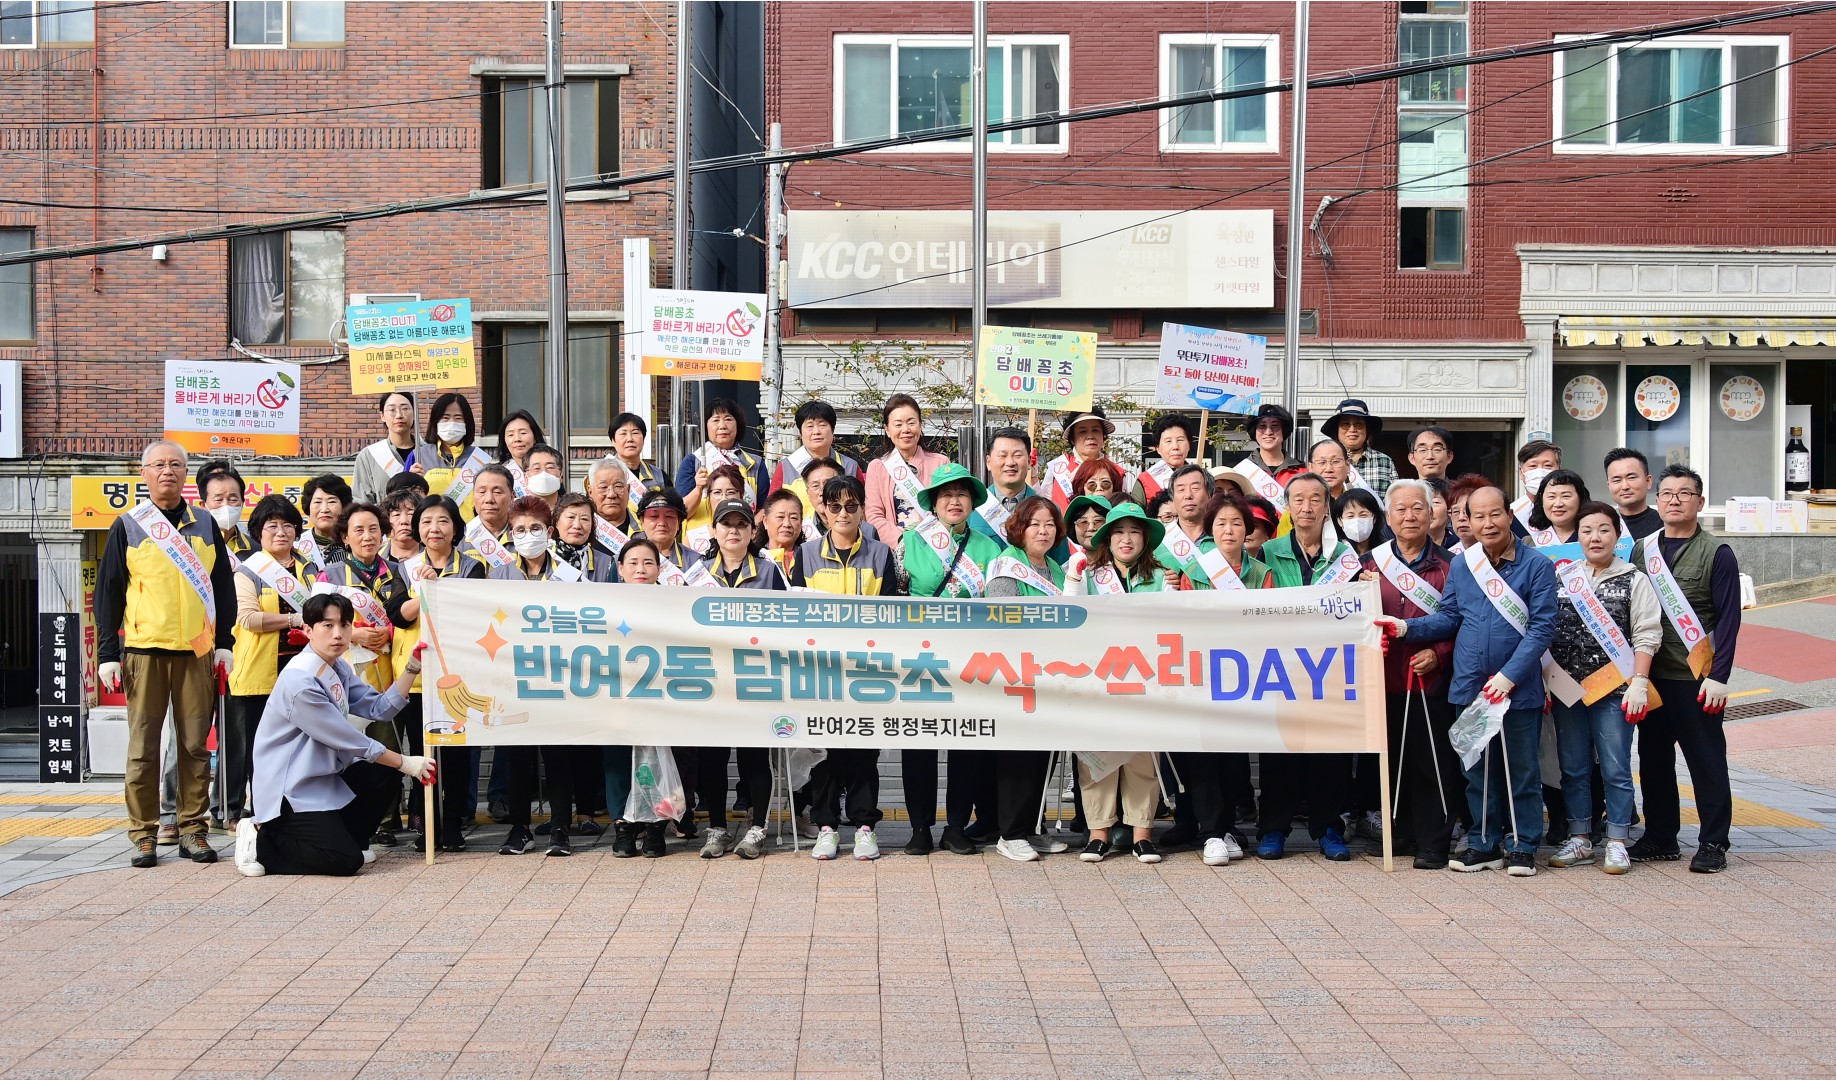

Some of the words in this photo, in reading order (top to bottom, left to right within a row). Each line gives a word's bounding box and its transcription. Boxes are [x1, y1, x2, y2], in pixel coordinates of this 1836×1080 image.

[1135, 226, 1169, 243] KCC
[654, 306, 695, 319] 담배꽁초
[353, 317, 388, 329] 담배꽁초
[391, 315, 416, 326] OUT!
[653, 320, 693, 333] 올바르게
[696, 322, 726, 335] 버리기
[353, 330, 386, 342] 담배꽁초
[389, 329, 404, 339] 없는
[407, 327, 439, 338] 아름다운
[441, 325, 465, 336] 해운대
[681, 336, 709, 345] 해운대를
[712, 338, 733, 346] 만들기
[737, 339, 751, 347] 위한
[366, 350, 422, 361] 미세플라스틱
[427, 347, 459, 357] 해양오염
[1176, 349, 1210, 364] 무단투기
[1211, 354, 1248, 369] 담배꽁초!
[360, 363, 392, 375] 토양오염
[398, 361, 430, 372] 화재원인
[677, 362, 707, 370] 해운대구
[709, 363, 737, 372] 반여2동
[175, 376, 221, 389] 담배꽁초
[388, 373, 419, 383] 해운대구
[422, 372, 449, 381] 반여2동
[1009, 375, 1053, 394] OUT!
[1164, 365, 1181, 377] 돌고
[1185, 368, 1202, 380] 돌아
[1204, 370, 1229, 384] 당신의
[1231, 375, 1260, 388] 식탁에!
[175, 390, 220, 404] 올바르게
[223, 393, 255, 406] 버리기
[212, 408, 242, 417] 해운대를
[245, 409, 267, 418] 만들기
[270, 410, 284, 418] 위한
[239, 420, 276, 428] 시작입니다
[450, 481, 467, 500] 담배
[902, 479, 919, 498] 담배
[600, 523, 629, 544] 담배꽁
[171, 535, 202, 573] 담배꽁초
[1413, 586, 1441, 613] 담배꽁
[1655, 573, 1685, 617] 담배꽁초
[708, 602, 799, 624] 담배꽁초는
[805, 603, 900, 625] 쓰레기통에!
[1255, 607, 1266, 616] 좋은
[1282, 606, 1294, 615] 오고
[1308, 605, 1319, 614] 도시
[1575, 600, 1594, 624] 아름다운
[1580, 588, 1611, 628] 담배꽁초
[1607, 625, 1625, 648] 없는
[520, 605, 608, 634] 오늘은
[53, 633, 67, 704] 도깨비헤어
[513, 645, 716, 701] 반여2동
[733, 648, 954, 704] 담배꽁초
[807, 717, 876, 737] 반여2동
[882, 716, 997, 738] 행정복지센터
[48, 739, 73, 753] 컷트
[48, 760, 73, 774] 염색
